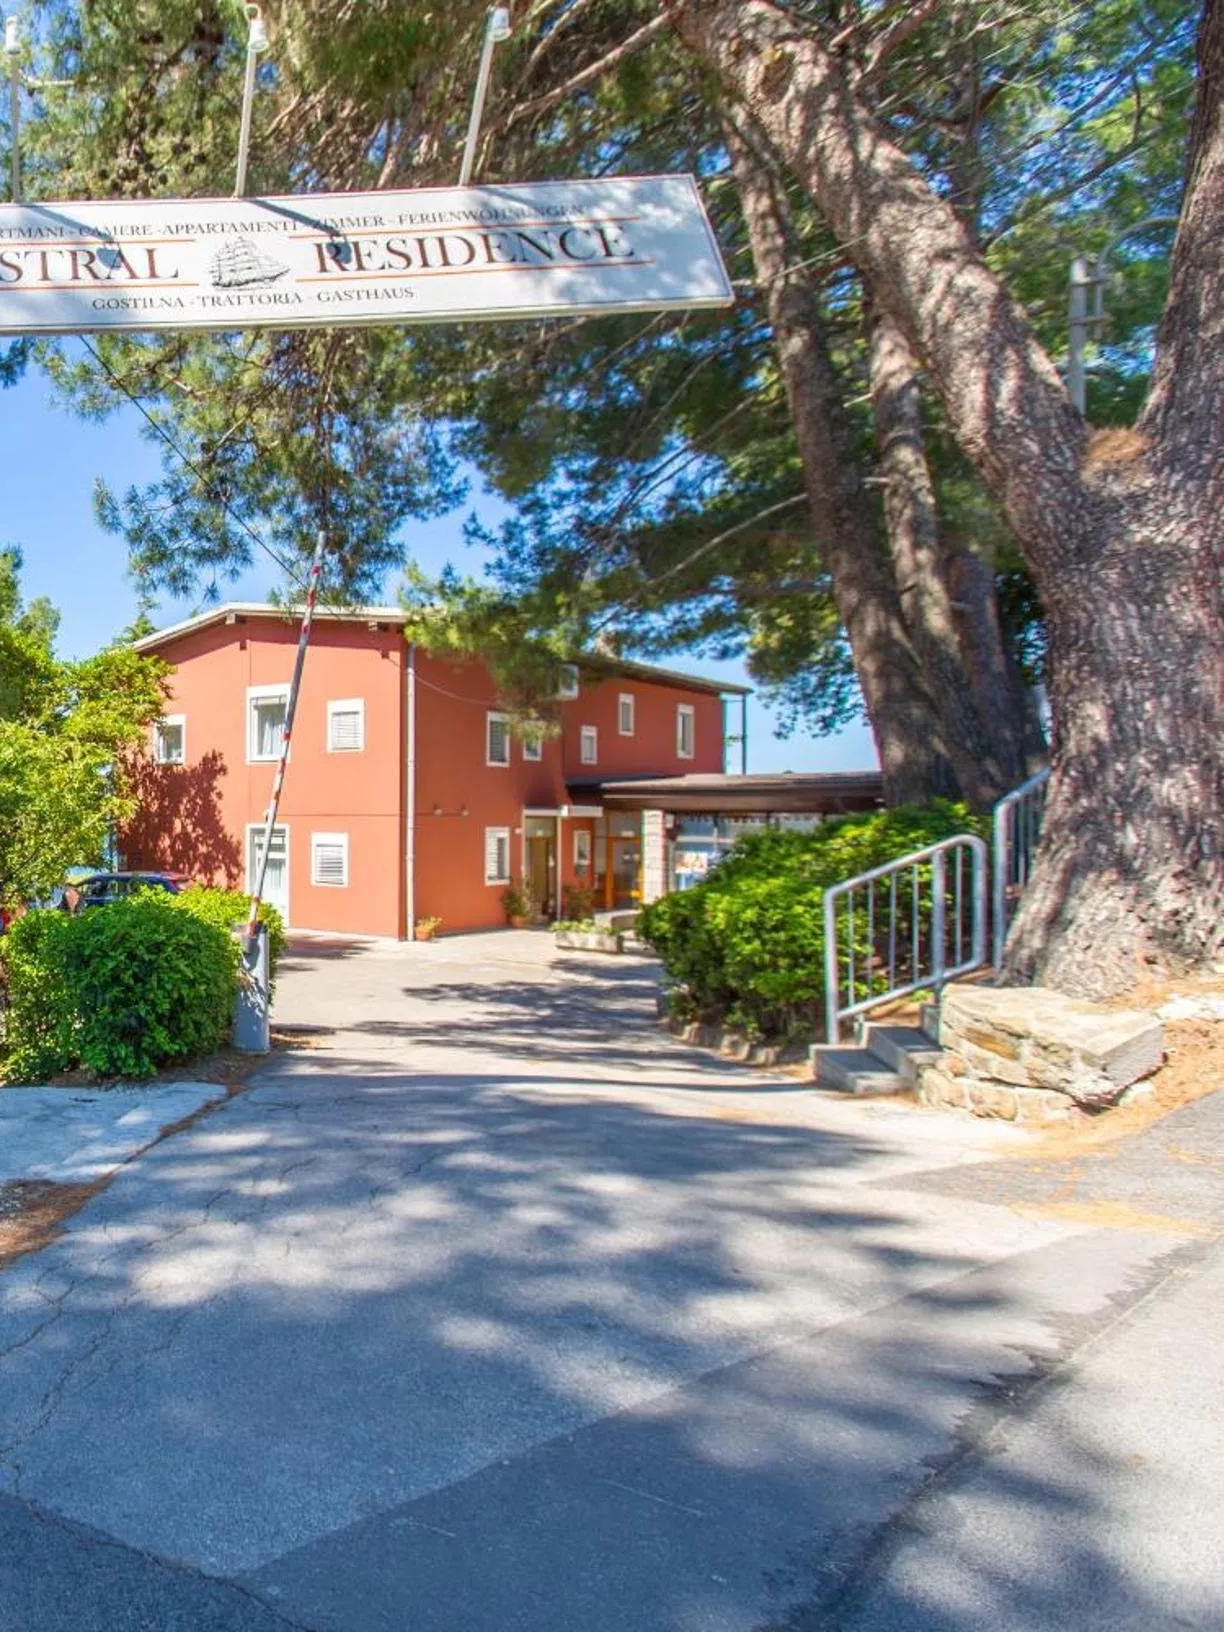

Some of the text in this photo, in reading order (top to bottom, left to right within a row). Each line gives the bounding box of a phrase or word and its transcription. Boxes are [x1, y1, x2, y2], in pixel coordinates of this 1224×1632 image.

[313, 225, 635, 274] RESIDENCE
[91, 296, 184, 310] GOSTILNA
[196, 292, 303, 308] TRATTORIA
[316, 286, 415, 302] GASTHAUS
